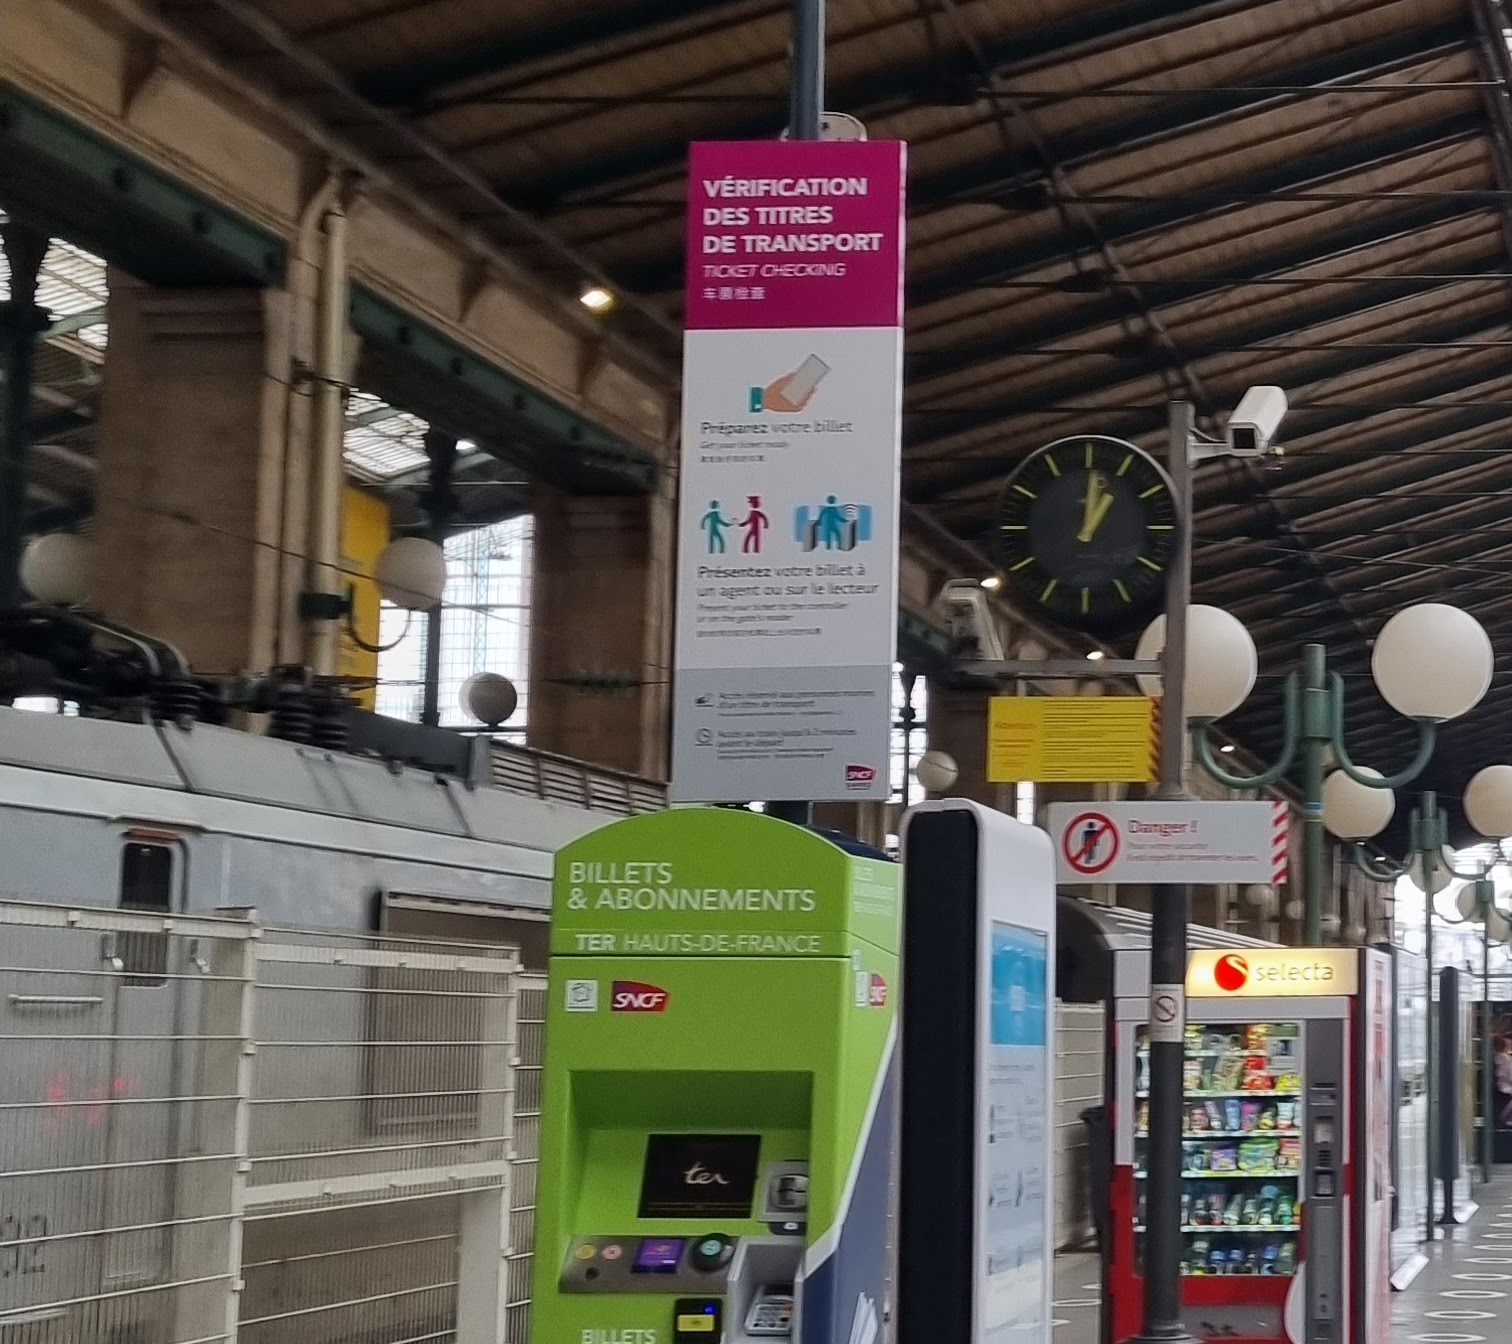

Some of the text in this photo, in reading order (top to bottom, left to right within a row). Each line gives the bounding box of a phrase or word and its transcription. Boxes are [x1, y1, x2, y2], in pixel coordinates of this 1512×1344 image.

[703, 175, 868, 198] VÉRIFICATION
[703, 206, 834, 226] DES TITRES
[703, 233, 884, 254] DE TRANSPORT
[701, 262, 847, 278] TICKET CHECKING
[771, 423, 812, 433] votre
[813, 419, 854, 433] billet
[698, 565, 771, 578] Présentez
[775, 566, 812, 577] votre
[815, 563, 853, 577] billet
[719, 586, 760, 600] agent
[785, 585, 808, 596] sur
[828, 582, 880, 595] lecteur
[1128, 819, 1188, 837] Danger
[569, 862, 673, 884] BILLETS
[567, 888, 816, 912] & ABONNEMENTS
[575, 934, 821, 954] TER HAUTS-DE-FRANCE
[1255, 962, 1334, 981] selecta
[612, 992, 667, 1009] SNCF
[683, 1161, 730, 1185] ter
